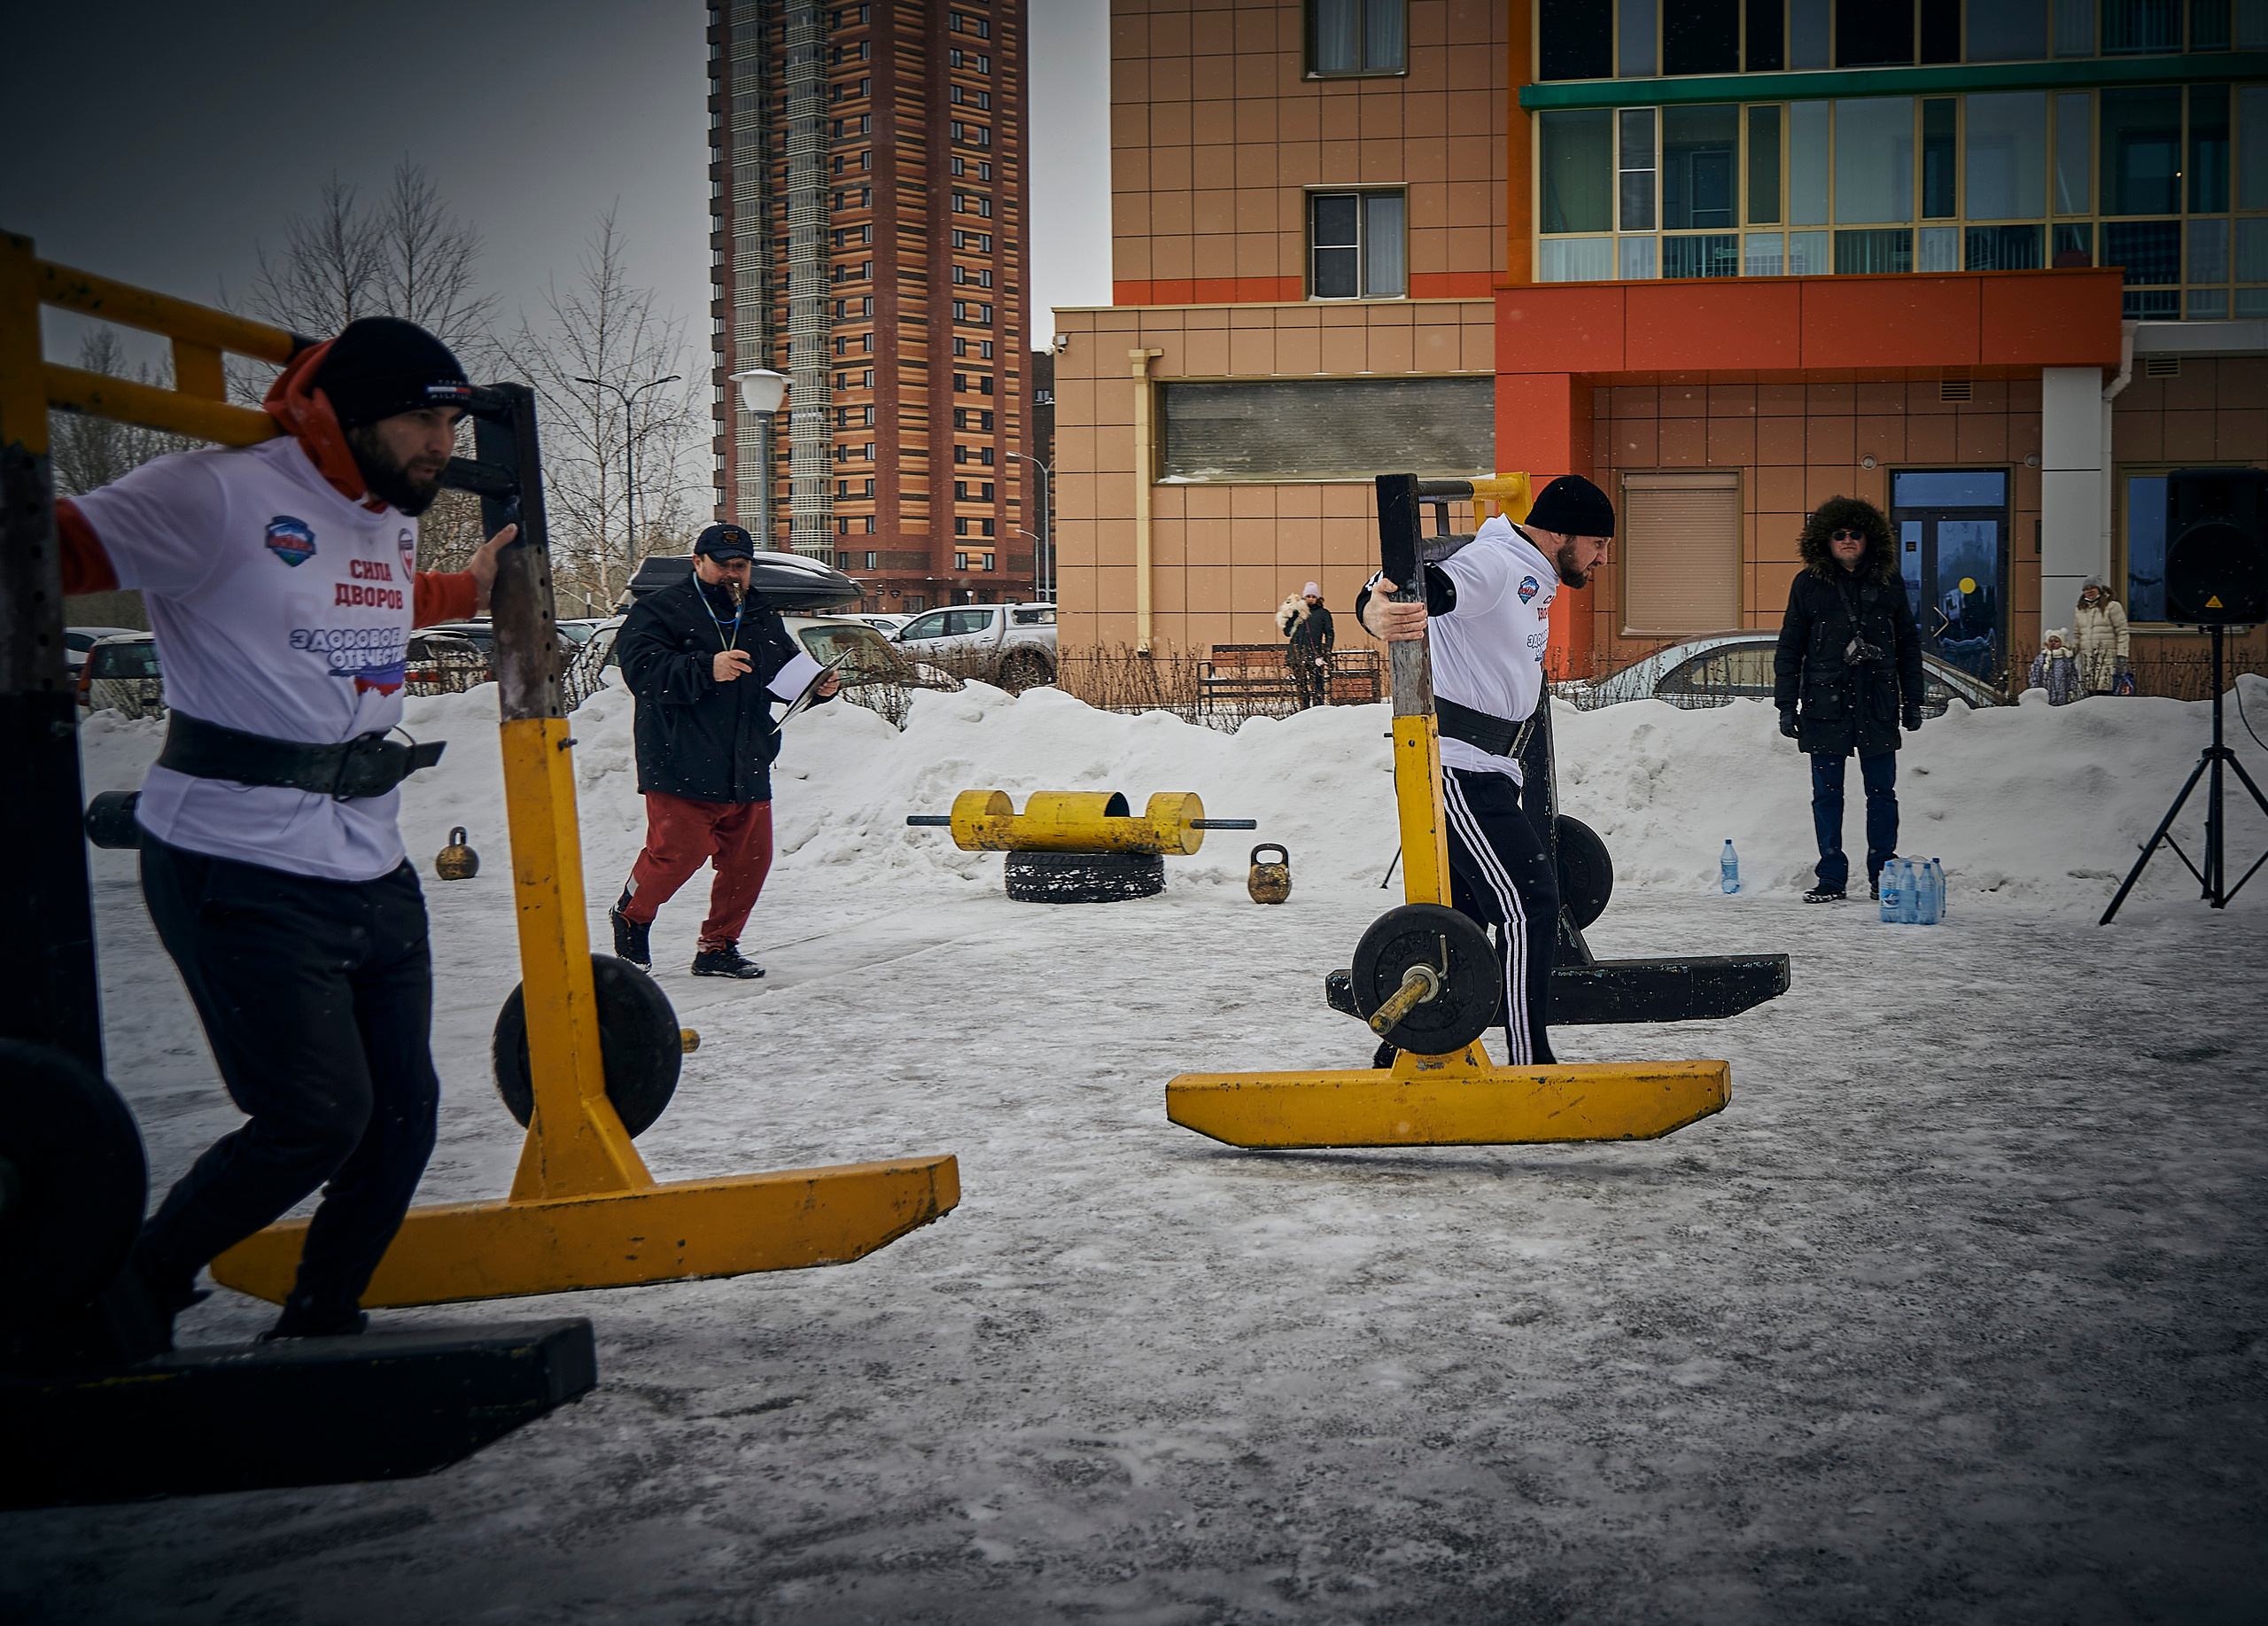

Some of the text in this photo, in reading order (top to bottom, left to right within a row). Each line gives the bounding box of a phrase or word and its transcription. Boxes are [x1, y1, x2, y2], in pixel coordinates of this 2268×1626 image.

[349, 558, 393, 582] СИЛА
[335, 583, 404, 610] ДВОРОВ
[290, 627, 401, 652] ЗДОРОВОЕ
